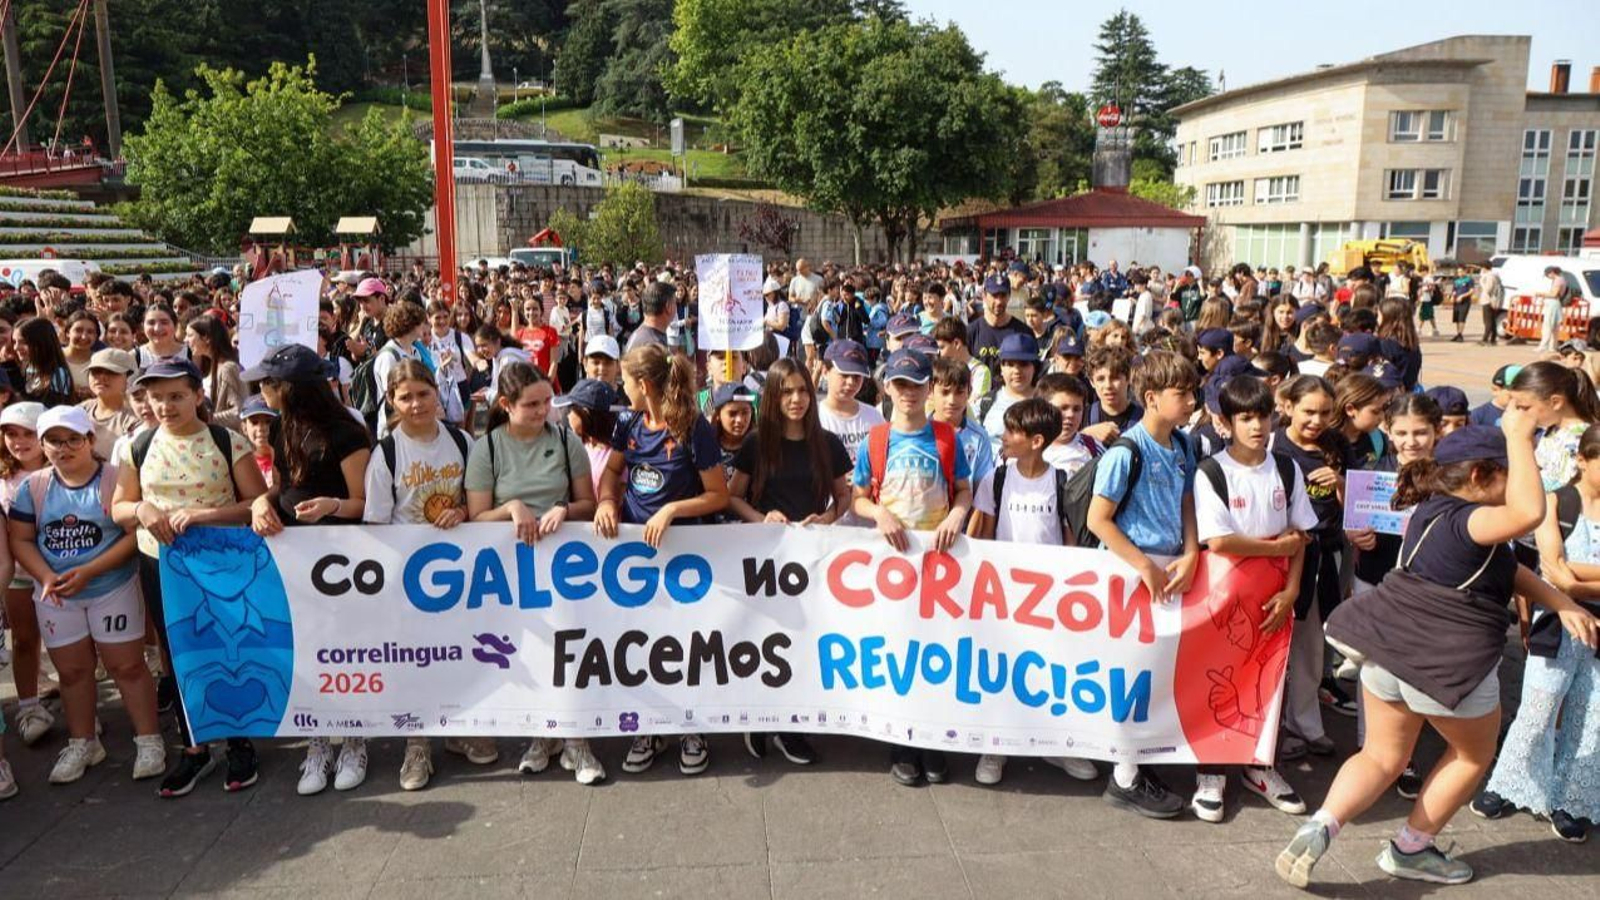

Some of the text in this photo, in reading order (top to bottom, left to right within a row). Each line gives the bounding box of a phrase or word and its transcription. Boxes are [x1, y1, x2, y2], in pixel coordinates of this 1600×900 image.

[46, 525, 96, 538] Estrella
[103, 614, 128, 632] 10
[316, 641, 463, 668] correlingua
[318, 672, 384, 694] 2026
[293, 713, 319, 727] CIG
